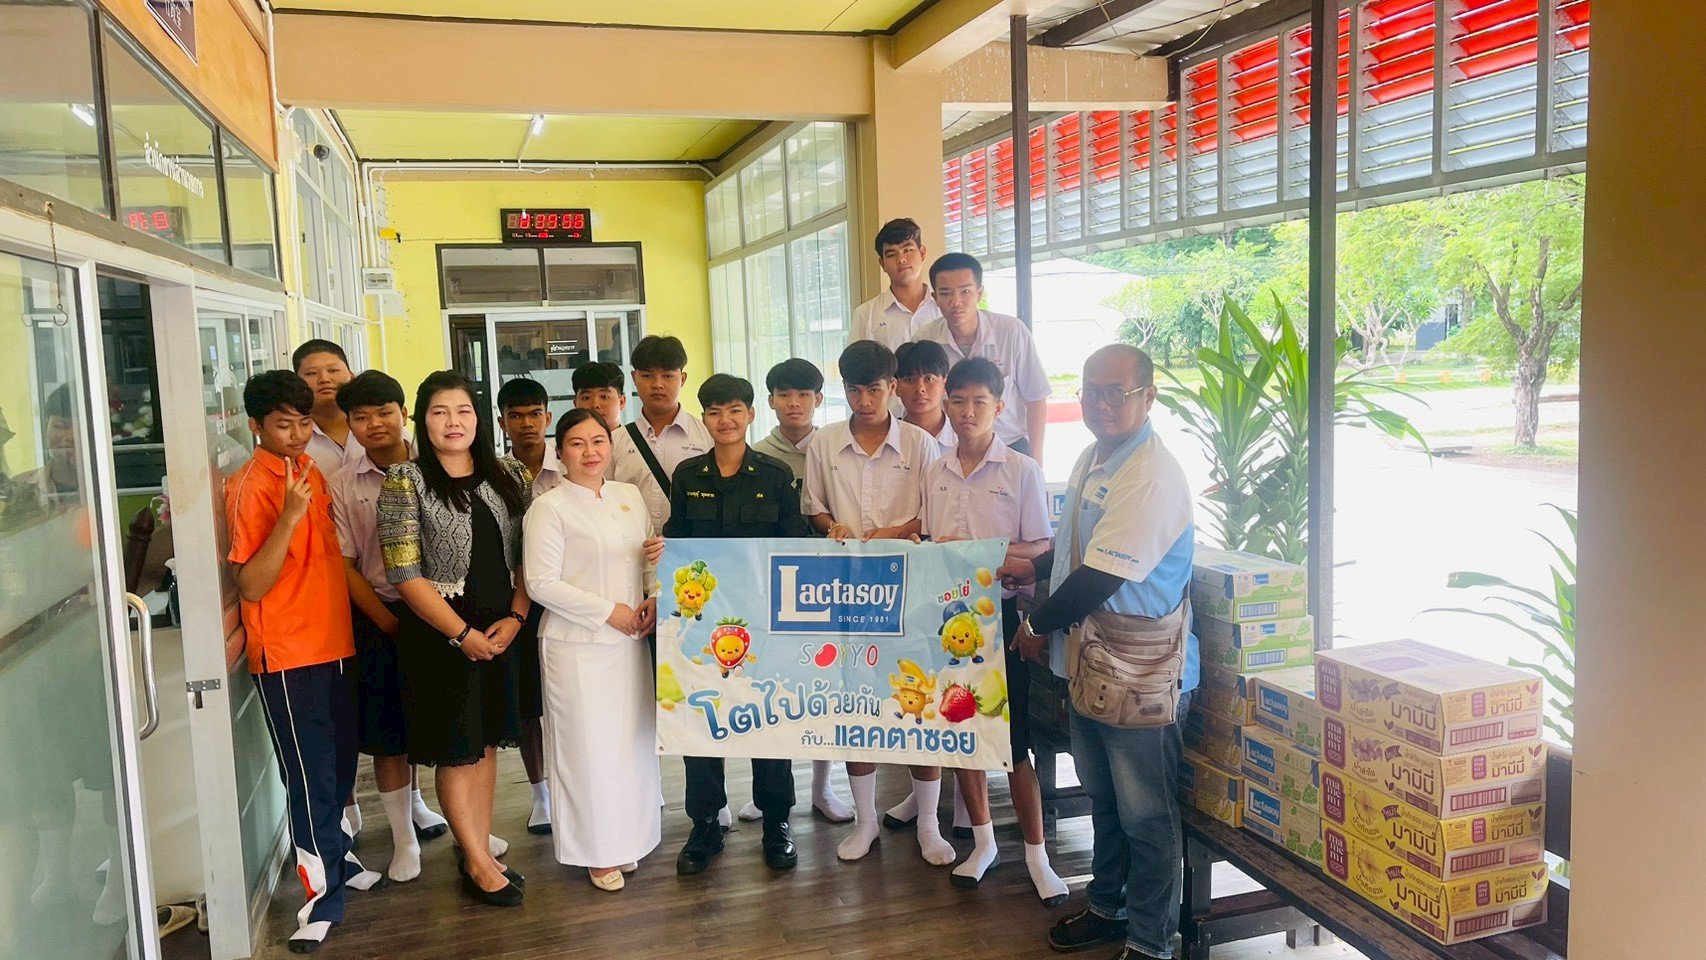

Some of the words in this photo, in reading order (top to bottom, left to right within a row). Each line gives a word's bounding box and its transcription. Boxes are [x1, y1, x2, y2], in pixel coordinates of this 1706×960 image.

[778, 565, 900, 621] Lactasoy
[838, 615, 865, 623] SINCE
[869, 615, 889, 623] 1981
[688, 679, 881, 741] โตไปด้วยกัน
[1249, 791, 1280, 820] Lactasoy
